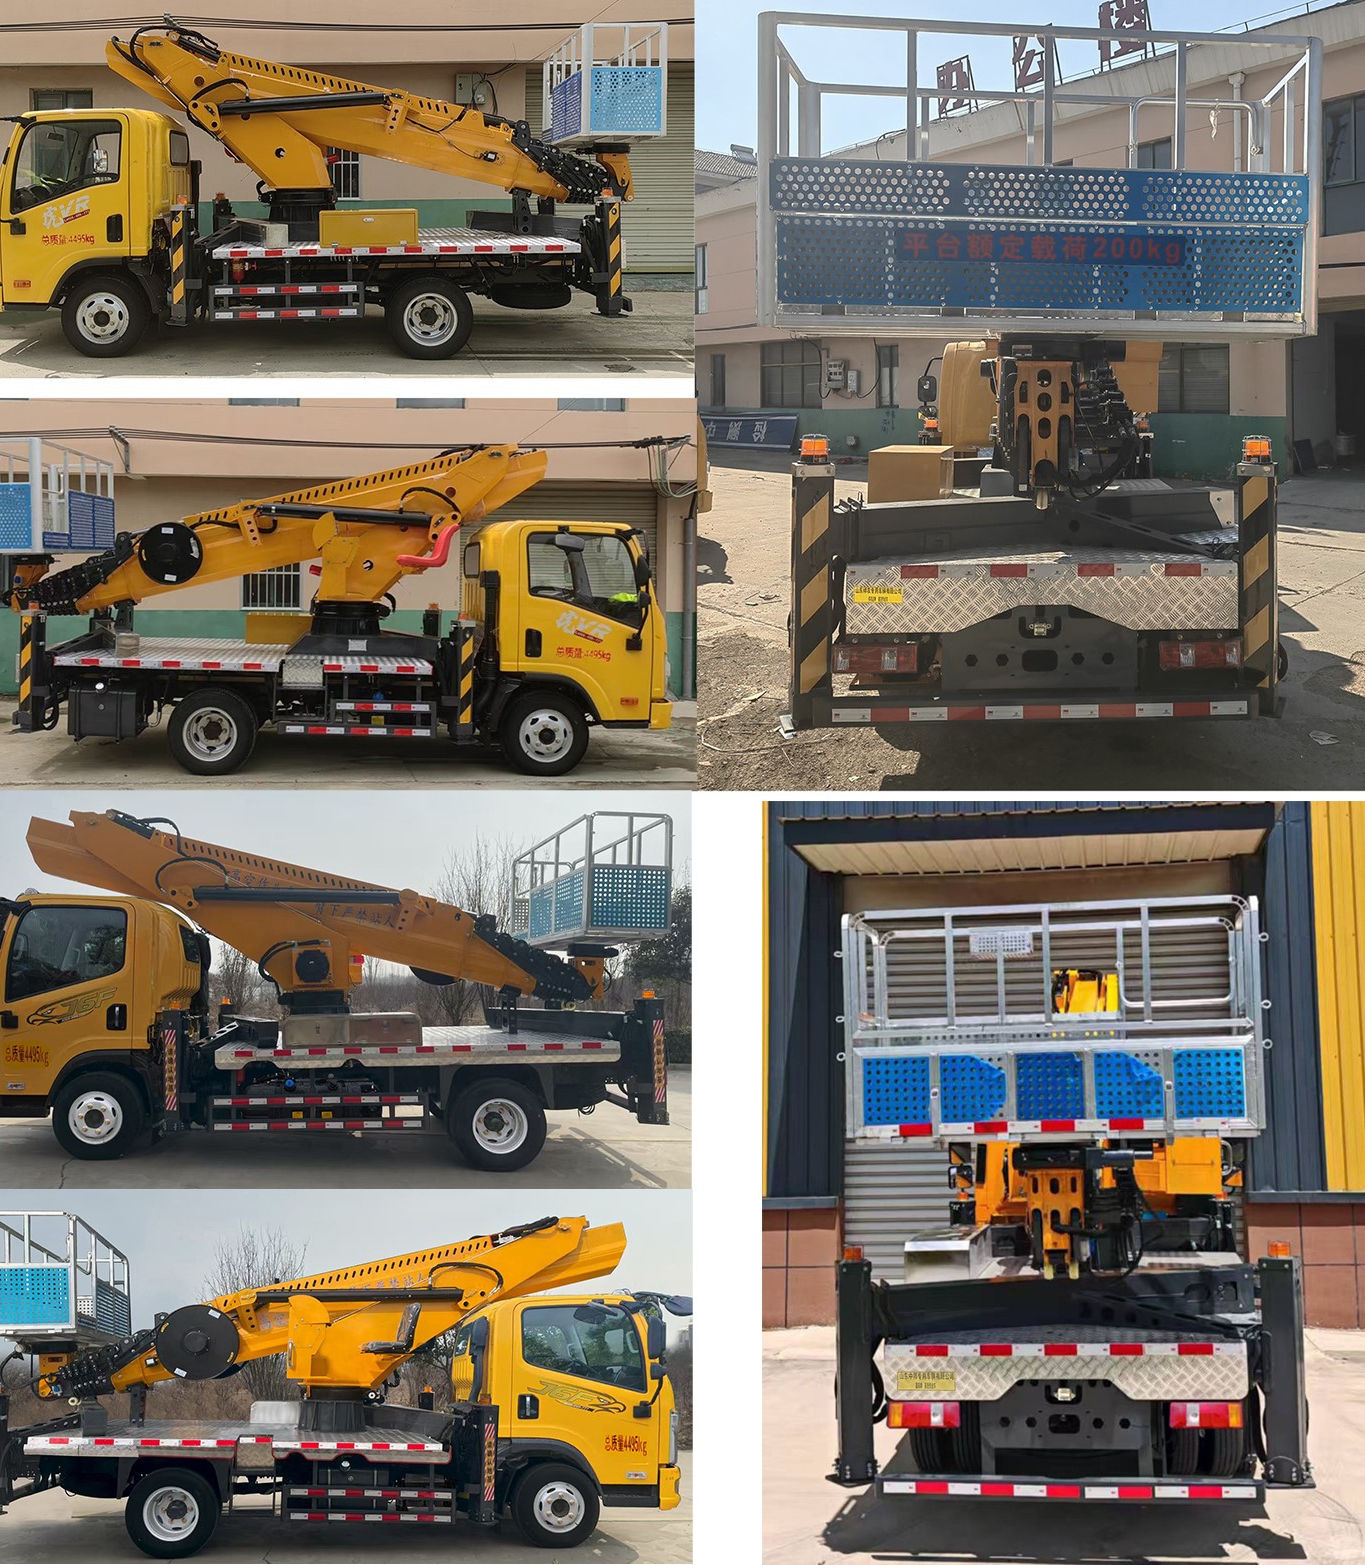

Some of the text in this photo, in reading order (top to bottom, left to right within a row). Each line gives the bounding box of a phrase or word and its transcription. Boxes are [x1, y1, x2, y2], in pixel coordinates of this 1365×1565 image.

[904, 232, 1181, 263] 平台额定载荷200kg
